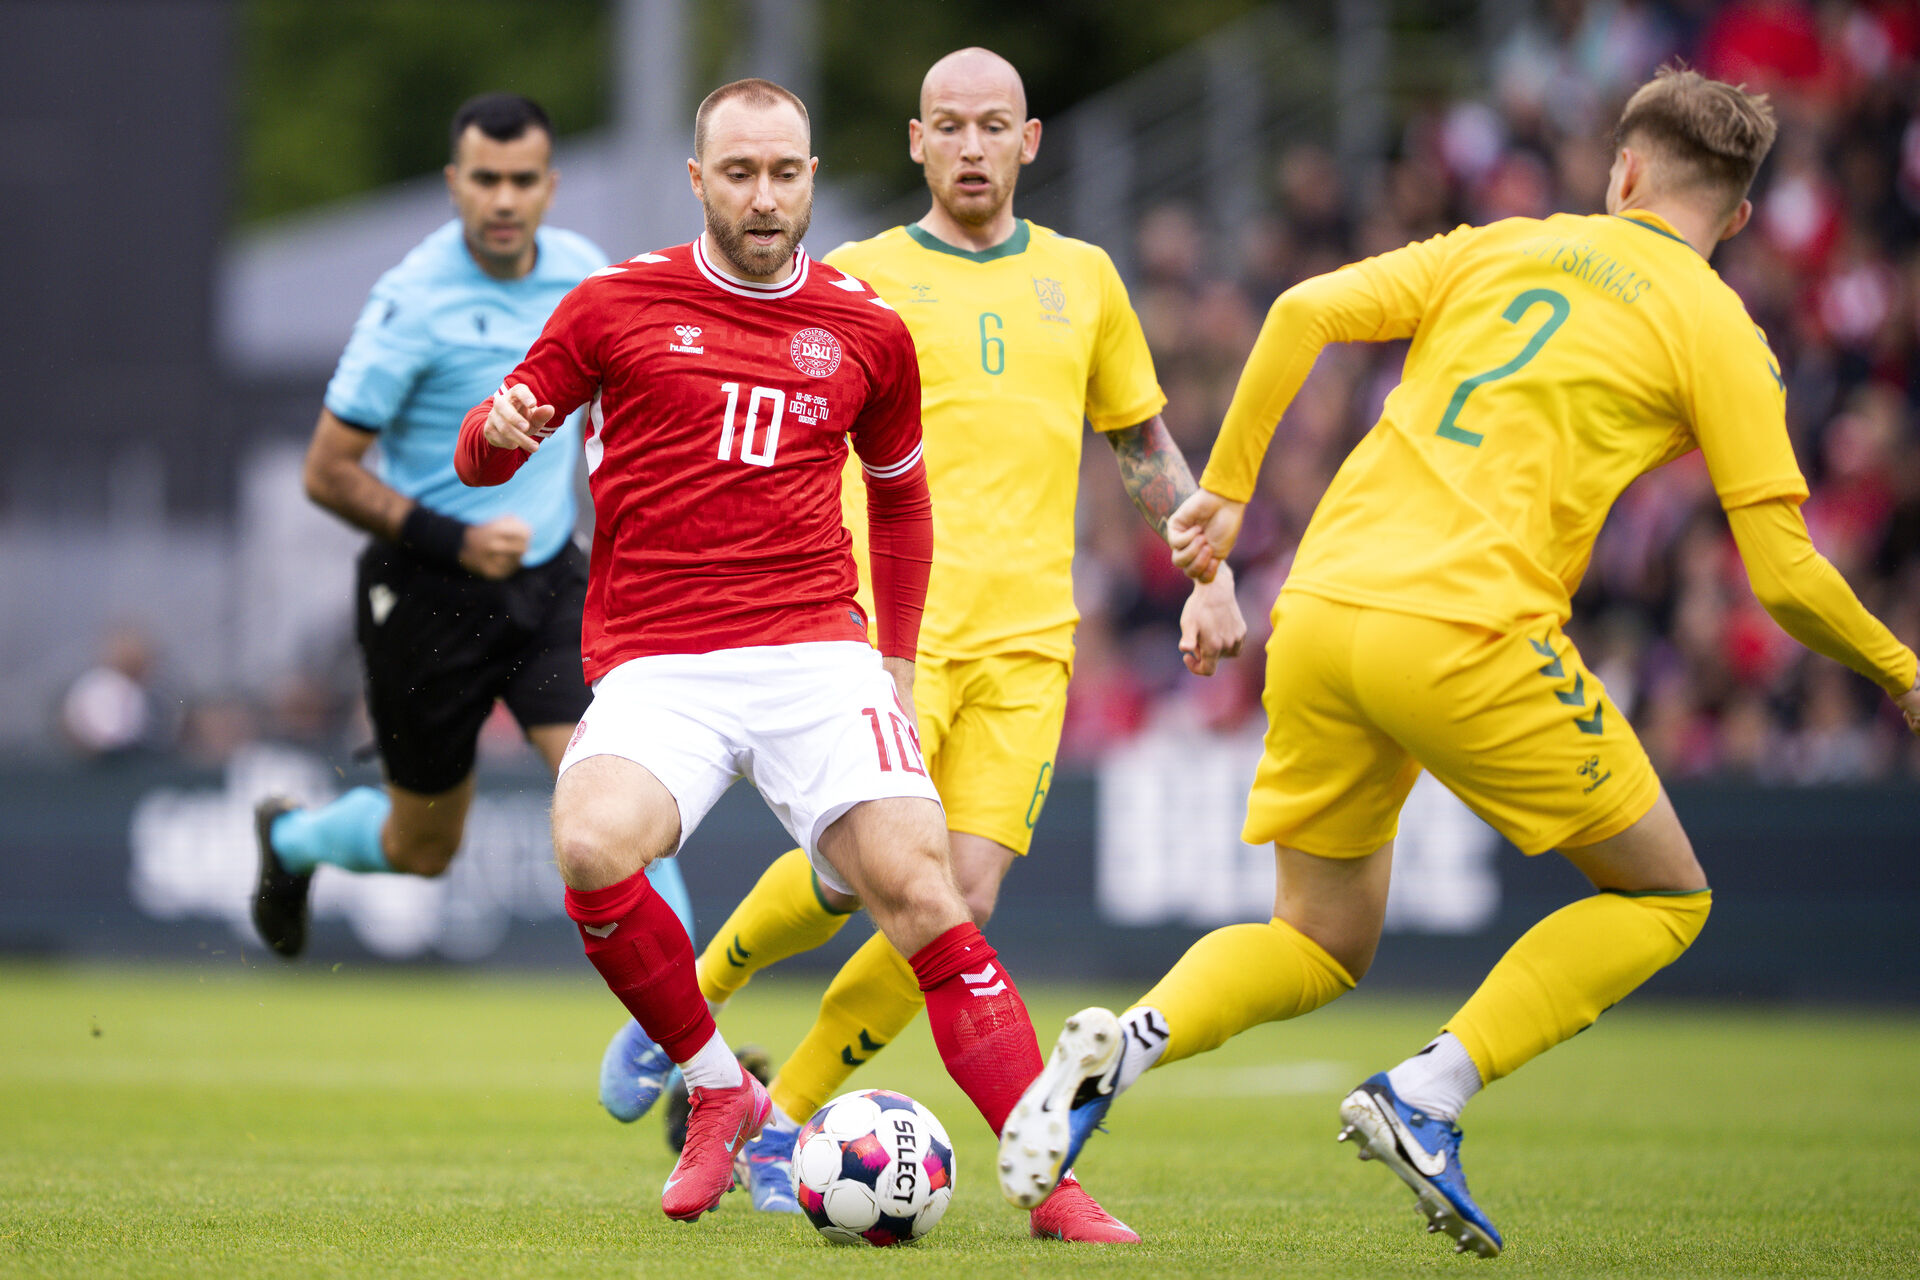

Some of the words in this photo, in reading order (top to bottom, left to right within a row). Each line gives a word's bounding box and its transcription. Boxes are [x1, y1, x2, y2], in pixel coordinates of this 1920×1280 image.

[669, 343, 704, 355] hummel
[801, 342, 830, 360] DBU
[979, 312, 1005, 376] 6
[1435, 288, 1571, 447] 2
[717, 382, 786, 467] 10
[789, 400, 806, 415] DEN
[813, 405, 829, 420] LTU
[1025, 761, 1052, 829] 6
[893, 1120, 917, 1204] SELECT
